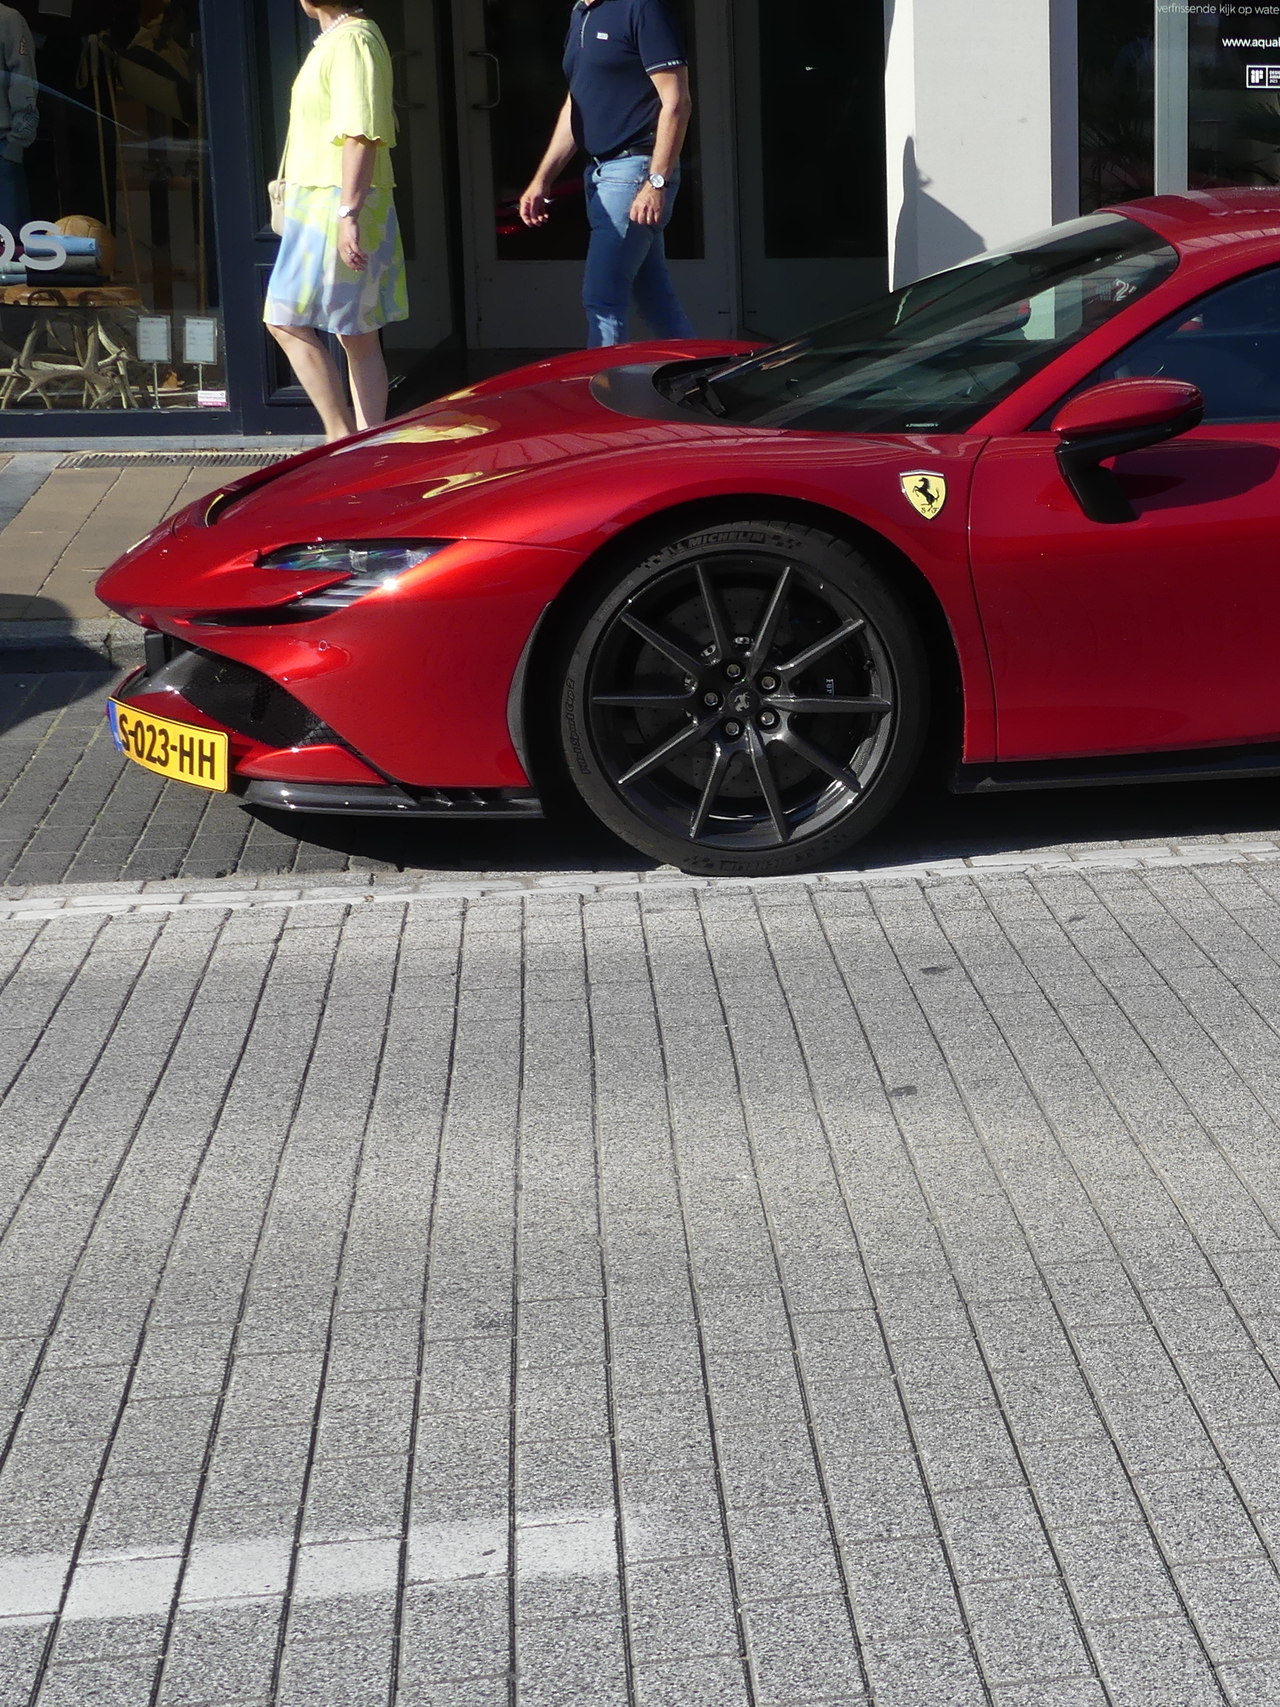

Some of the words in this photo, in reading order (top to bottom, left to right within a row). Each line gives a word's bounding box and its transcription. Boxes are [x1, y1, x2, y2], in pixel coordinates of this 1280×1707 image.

[1157, 3, 1217, 14] verfrissende
[1219, 4, 1236, 16] kijk
[1238, 6, 1253, 16] op
[687, 531, 765, 549] MICHELIN
[565, 678, 576, 690] 2
[565, 690, 575, 712] Cup
[566, 713, 581, 746] Sport
[119, 713, 215, 780] S-023-HH
